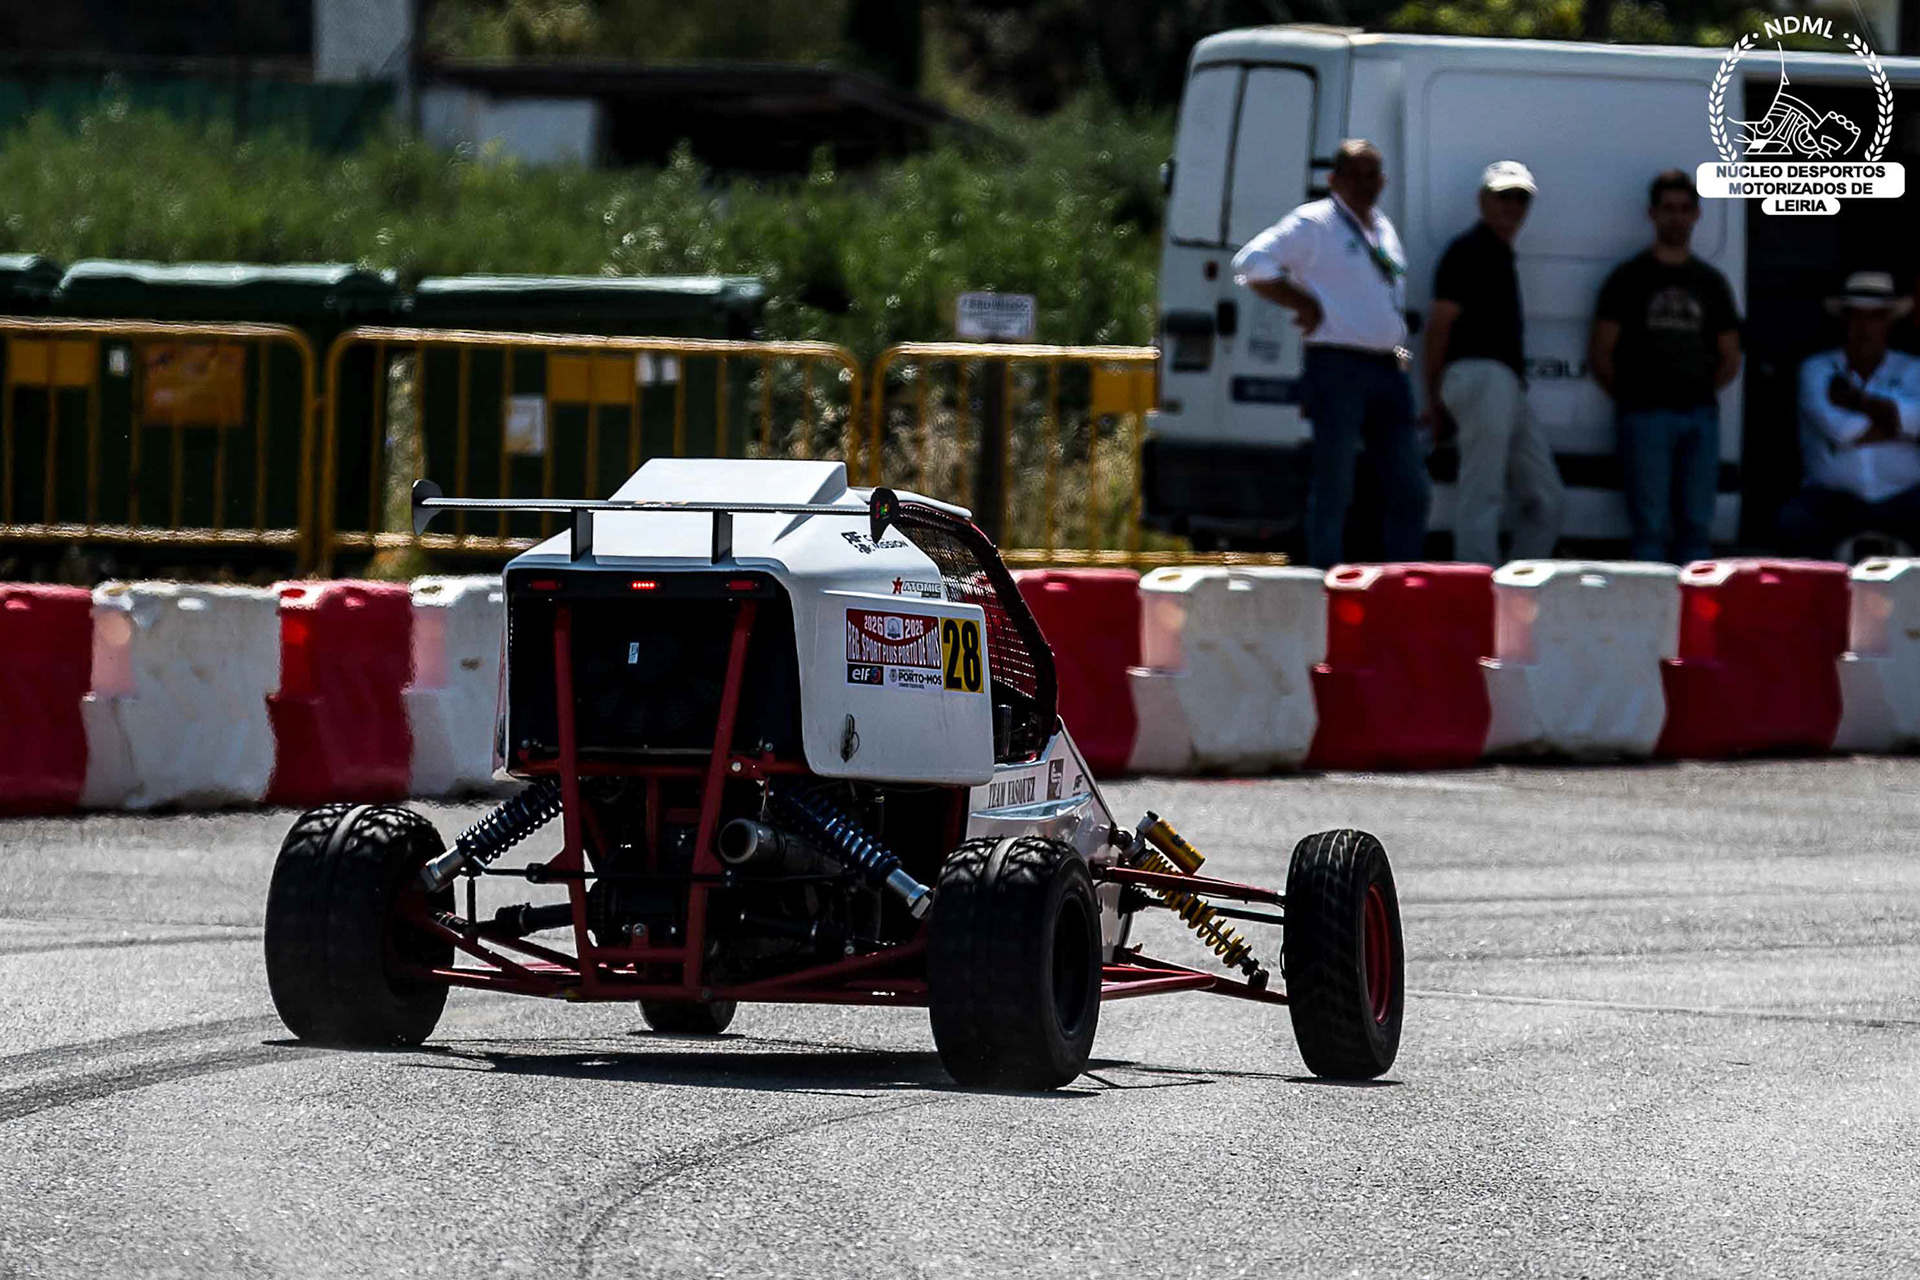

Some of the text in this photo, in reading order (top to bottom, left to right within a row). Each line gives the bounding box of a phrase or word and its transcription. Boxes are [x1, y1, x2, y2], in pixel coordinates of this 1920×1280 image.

[903, 580, 941, 593] ATOMIC
[864, 615, 884, 636] 2026
[861, 633, 882, 662] SPORT
[883, 643, 898, 663] PLUS
[899, 641, 918, 665] PORTO
[918, 635, 927, 665] DE
[943, 619, 981, 692] 28
[852, 667, 870, 681] elf
[988, 782, 1006, 809] TEAM
